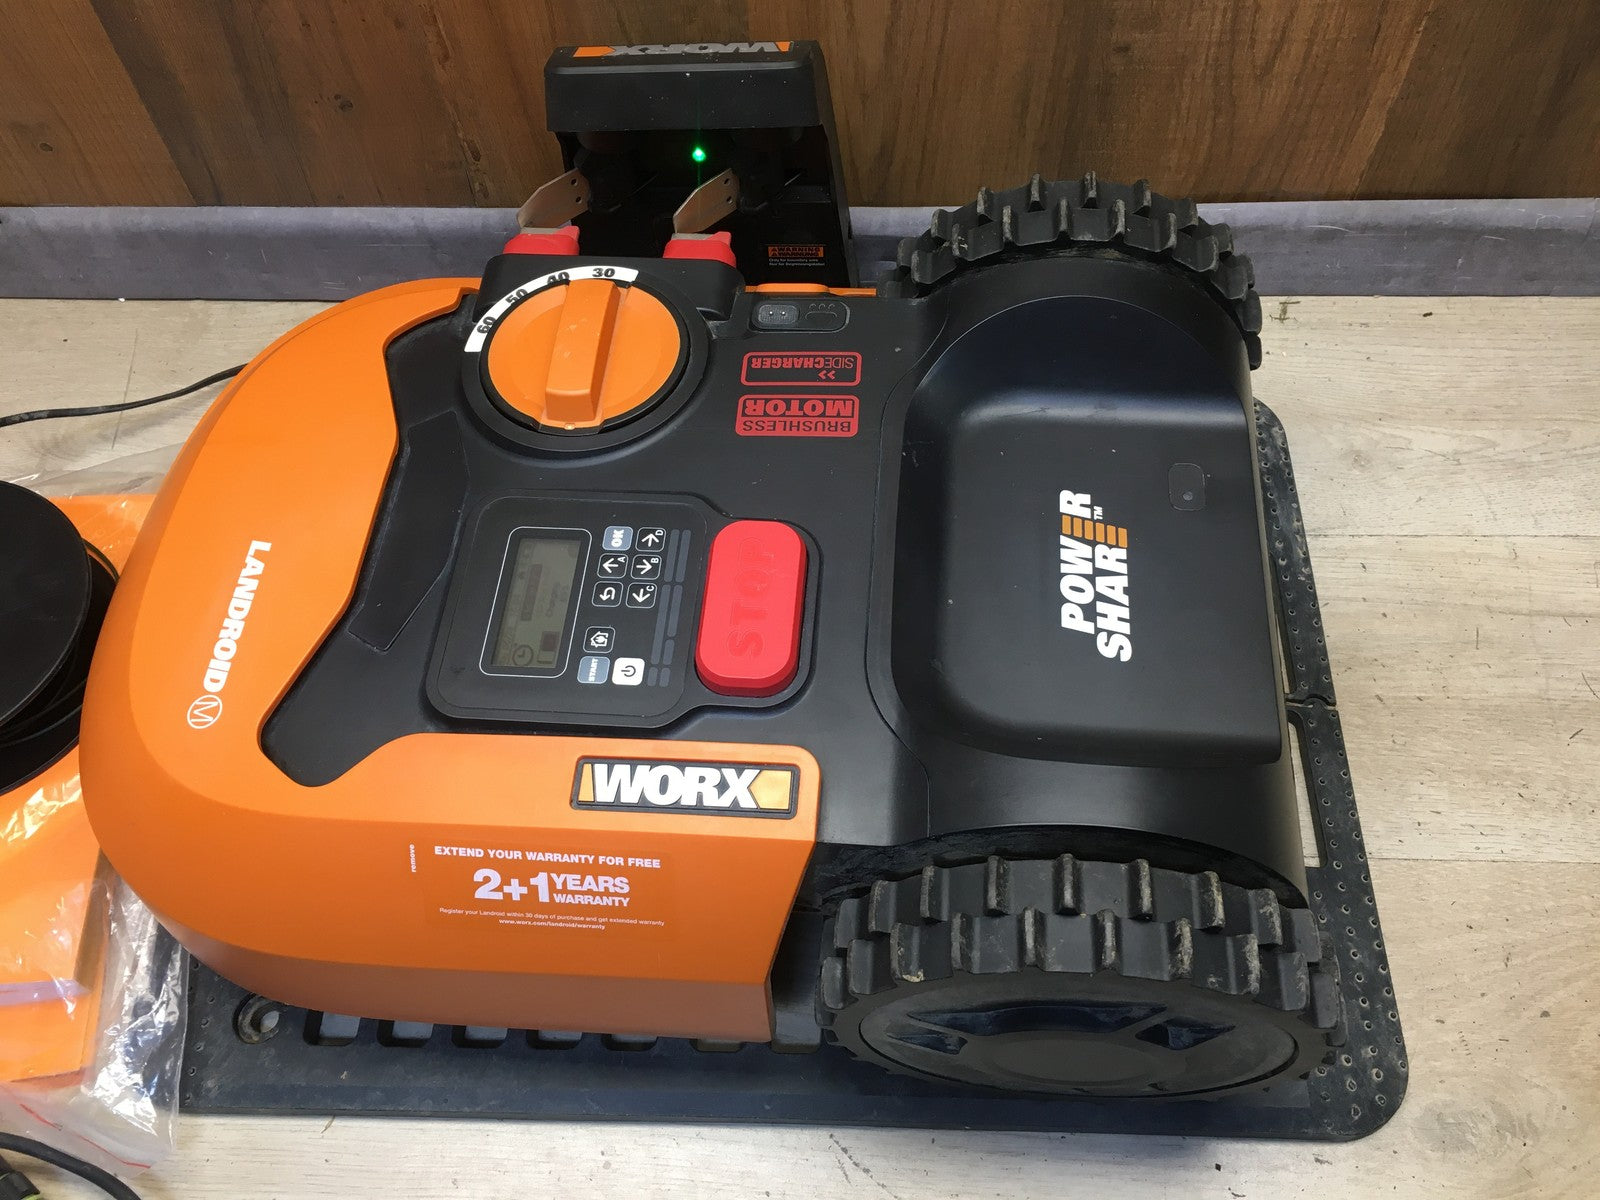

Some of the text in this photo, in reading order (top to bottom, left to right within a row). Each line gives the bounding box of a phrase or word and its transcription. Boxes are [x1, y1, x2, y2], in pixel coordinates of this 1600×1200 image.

[603, 41, 781, 56] WORX
[546, 271, 570, 285] 40
[592, 268, 616, 278] 30
[505, 288, 528, 304] 50
[477, 316, 496, 334] 60
[751, 357, 855, 369] SIDECHARGER
[744, 399, 853, 417] MOTOR
[742, 420, 851, 432] BRUSHLESS
[611, 529, 624, 548] OK
[727, 538, 774, 657] STOP
[203, 540, 272, 693] LANDROID
[588, 658, 598, 682] START
[593, 763, 761, 809] WORX
[409, 844, 417, 873] remove
[434, 845, 661, 869] EXTEND YOUR WARRANTY FOR FREE
[473, 868, 630, 903] 2+1 YEARS
[553, 893, 630, 907] WARRANTY
[439, 907, 464, 915] Register
[479, 909, 505, 917] Landroid
[533, 912, 549, 920] days
[557, 914, 585, 922] purchase
[499, 919, 605, 930] www.worx.com/landroid/warranty
